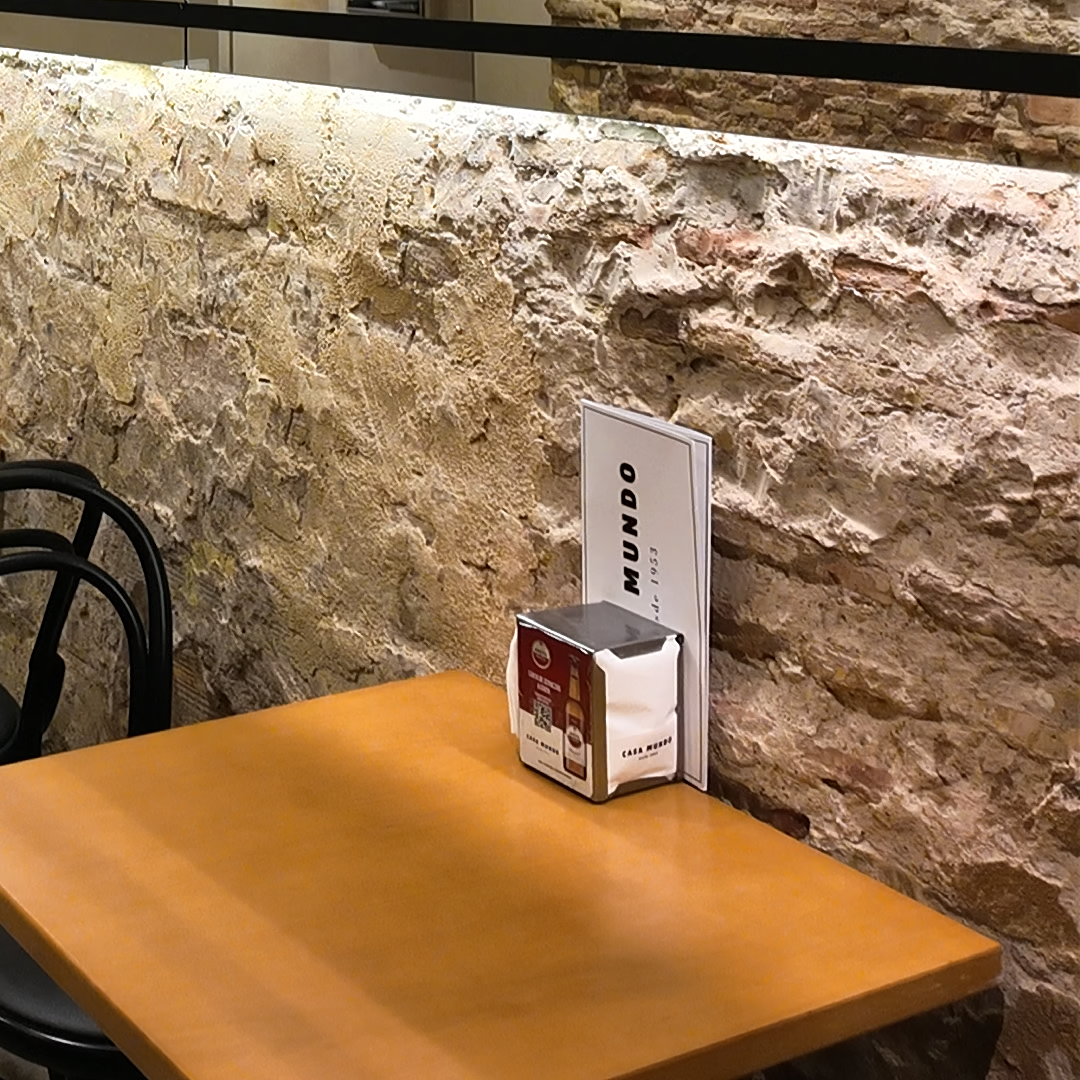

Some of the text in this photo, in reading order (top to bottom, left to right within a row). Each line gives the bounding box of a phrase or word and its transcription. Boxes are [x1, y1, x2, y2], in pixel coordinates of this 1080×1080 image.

[619, 462, 640, 596] MUNDO
[649, 546, 660, 586] 1953
[621, 747, 643, 758] CASA
